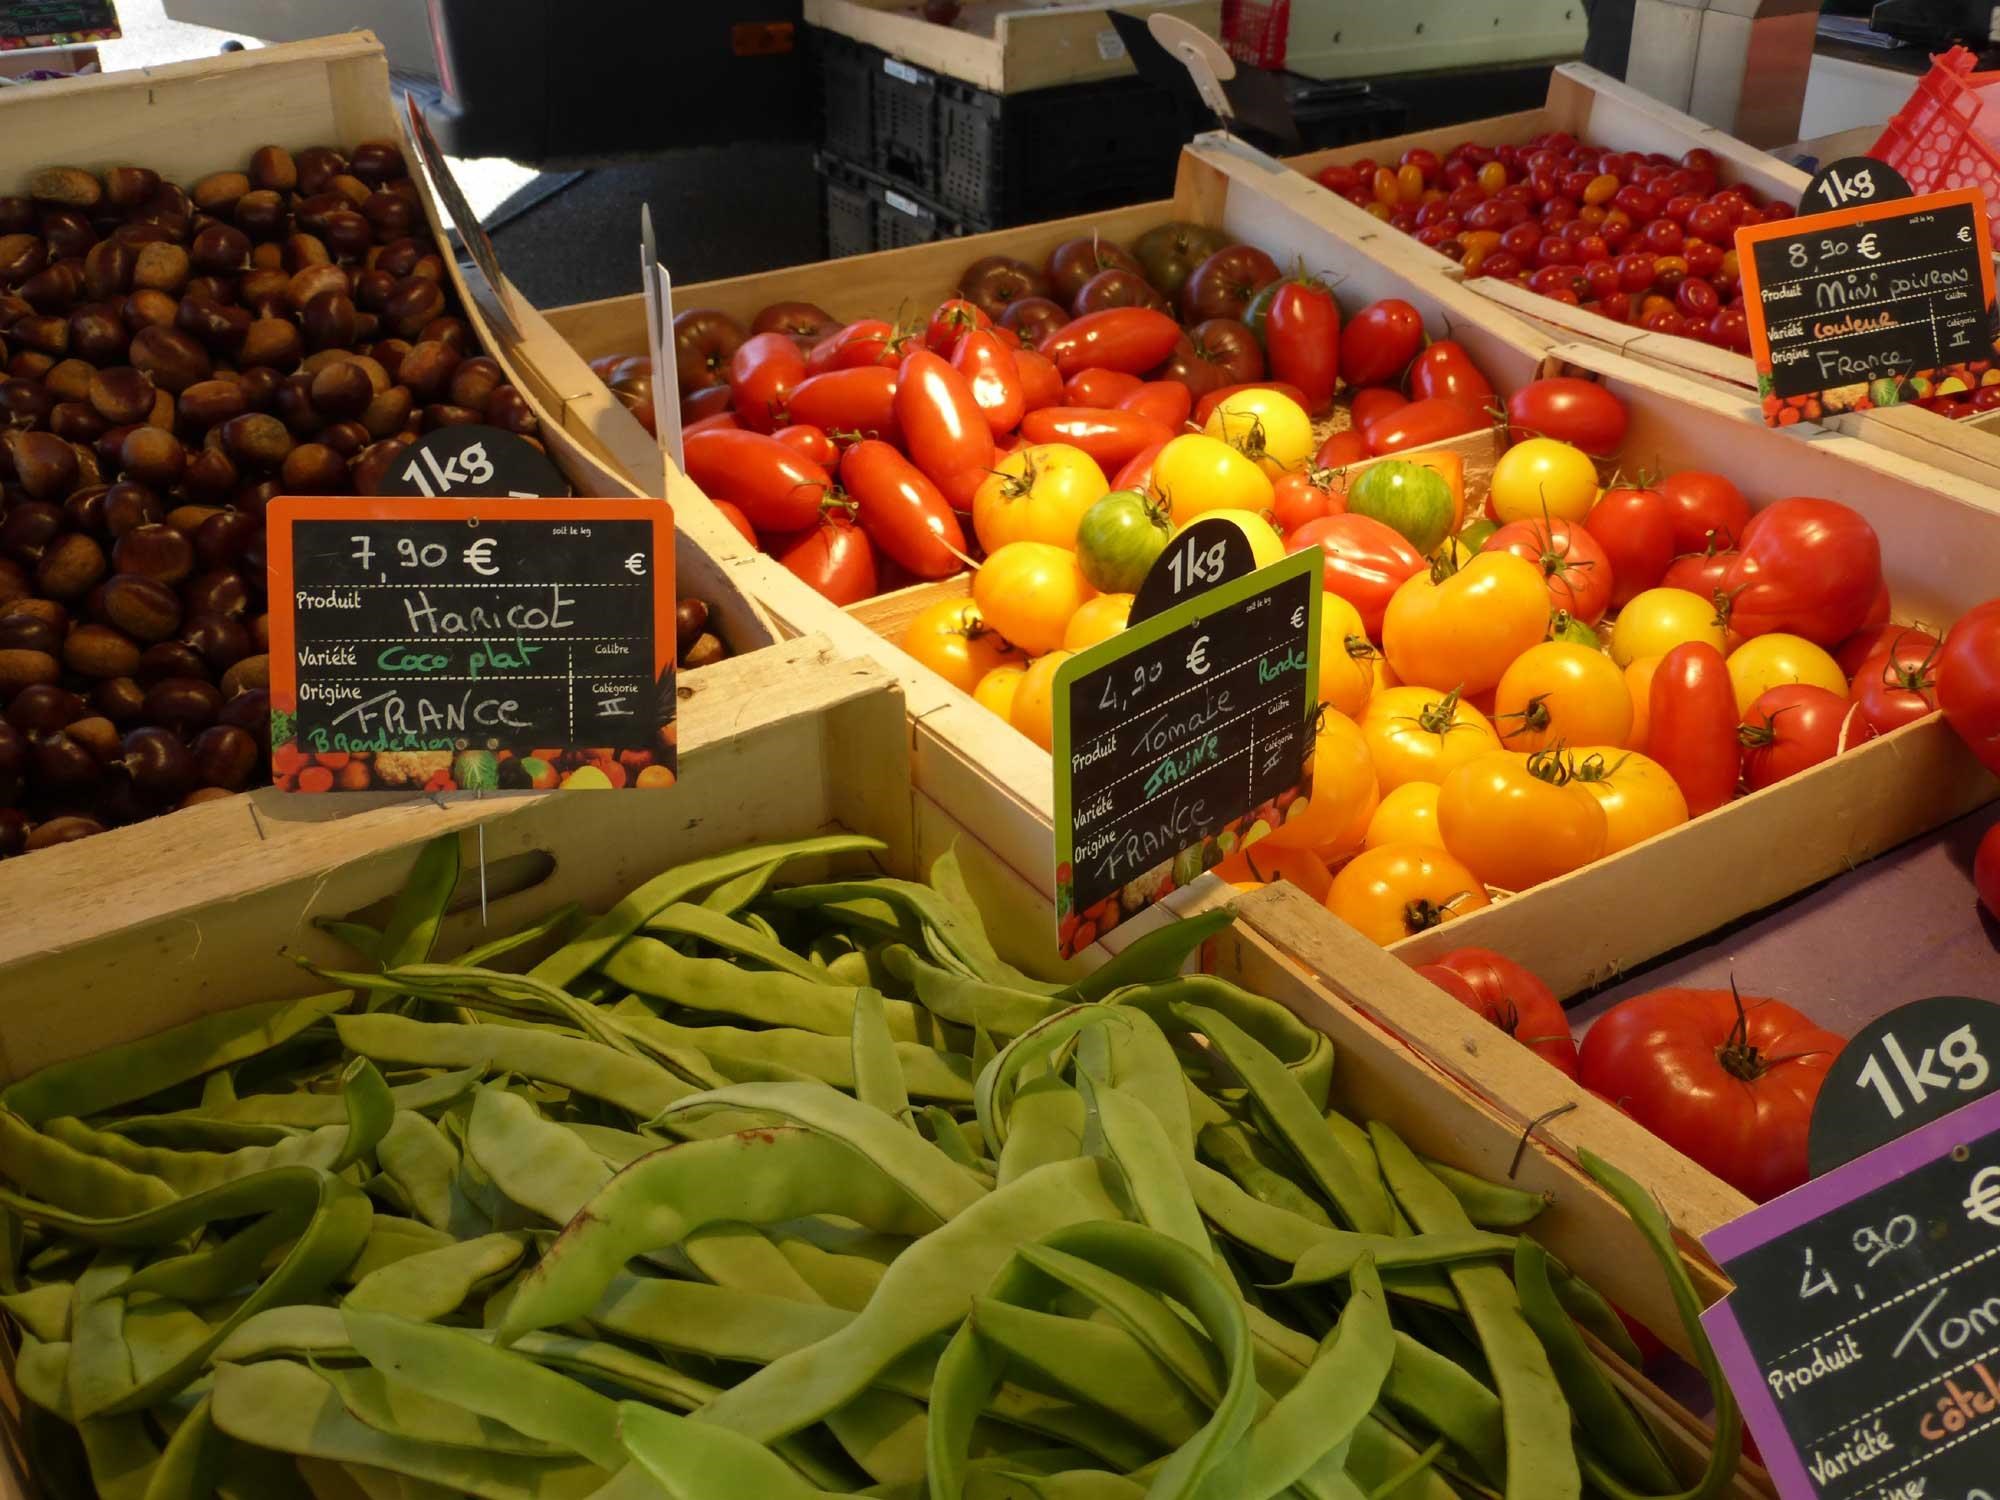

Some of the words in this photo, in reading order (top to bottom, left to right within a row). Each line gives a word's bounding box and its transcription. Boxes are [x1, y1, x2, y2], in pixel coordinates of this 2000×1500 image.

[1818, 169, 1875, 208] 1kg
[1957, 226, 1972, 243] €
[1788, 240, 1848, 273] 8,90
[1857, 233, 1881, 259] €
[1761, 284, 1803, 303] Produit
[1767, 321, 1805, 341] Variété
[1771, 348, 1810, 366] Origine
[402, 442, 494, 497] 1kg
[552, 526, 567, 535] soit
[570, 527, 578, 535] le
[580, 527, 592, 538] kg
[351, 536, 447, 583] 7,90
[463, 538, 500, 576] €
[624, 552, 647, 575] €
[1168, 536, 1226, 594] 1kg
[296, 589, 361, 609] Produit
[1290, 606, 1305, 628] €
[298, 645, 357, 666] Variété
[470, 633, 543, 682] plat
[595, 642, 630, 655] Calibre
[1099, 661, 1162, 711] 4,90
[1186, 635, 1211, 675] €
[300, 683, 362, 706] Origine
[592, 682, 638, 696] Catégorie
[596, 697, 634, 716] II
[1268, 699, 1290, 716] Calibre
[1131, 688, 1235, 757] Tomate
[1072, 734, 1117, 774] Produit
[1264, 732, 1294, 753] Catégorie
[1074, 790, 1113, 831] Variété
[1075, 831, 1116, 863] Origine
[1856, 1024, 1989, 1119] 1kg
[1801, 1215, 1917, 1300] 4,90
[1962, 1166, 2000, 1226] €
[1768, 1333, 1863, 1400] Produit
[1809, 1418, 1895, 1487] Variété
